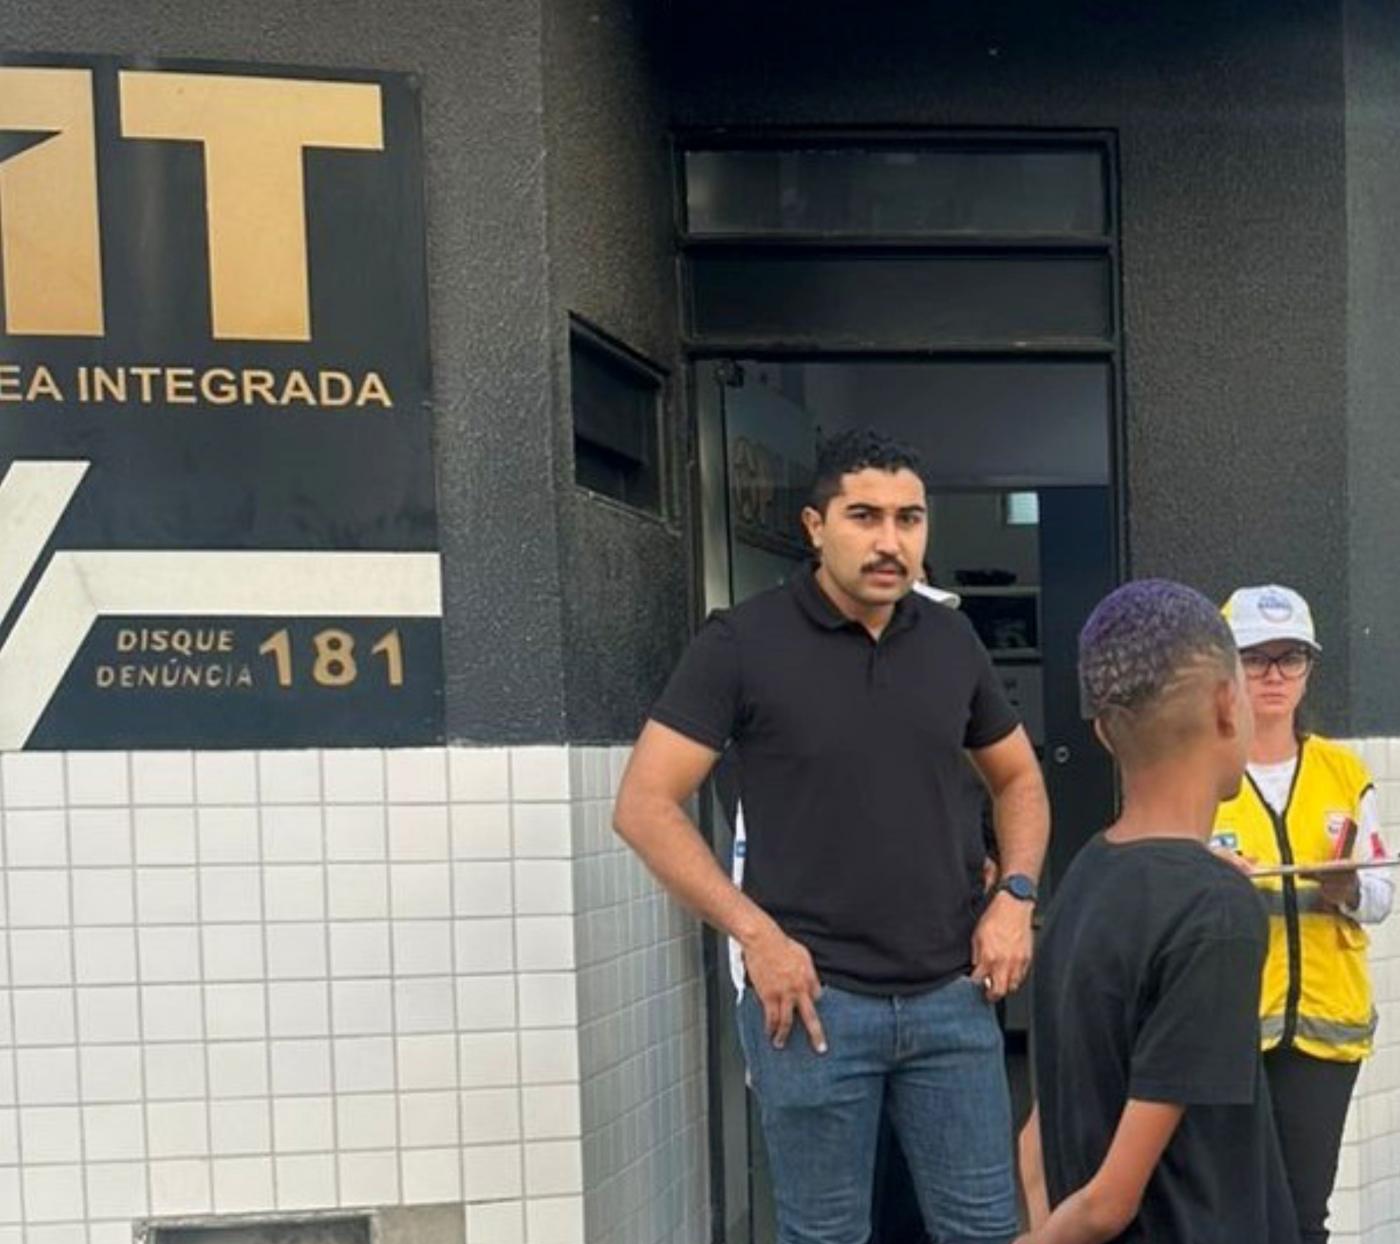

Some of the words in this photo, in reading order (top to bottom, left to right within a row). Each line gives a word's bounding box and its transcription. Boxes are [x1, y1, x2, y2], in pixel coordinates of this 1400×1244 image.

[77, 365, 393, 408] INTEGRADA
[116, 628, 235, 655] DISQUE
[259, 627, 404, 687] 181
[96, 657, 253, 687] DENÚNCIA
